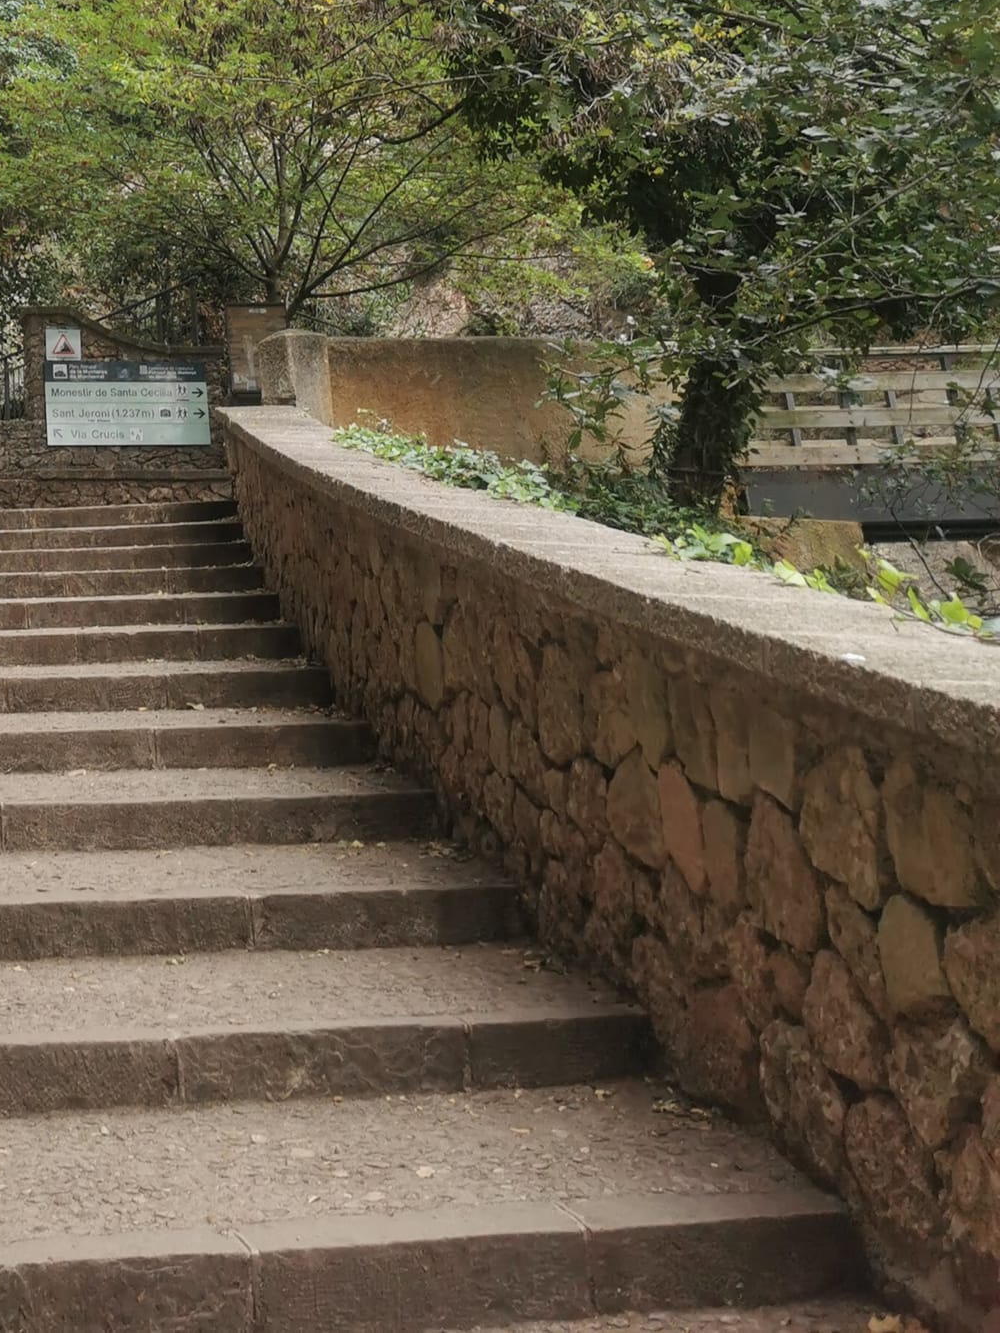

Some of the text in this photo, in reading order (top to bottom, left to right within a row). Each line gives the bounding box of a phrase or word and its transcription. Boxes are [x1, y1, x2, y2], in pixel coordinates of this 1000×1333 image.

[51, 387, 92, 397] Monestir
[95, 387, 107, 397] de
[110, 387, 138, 397] Santa
[52, 408, 75, 418] Sant
[70, 429, 125, 439] Via Crucis
